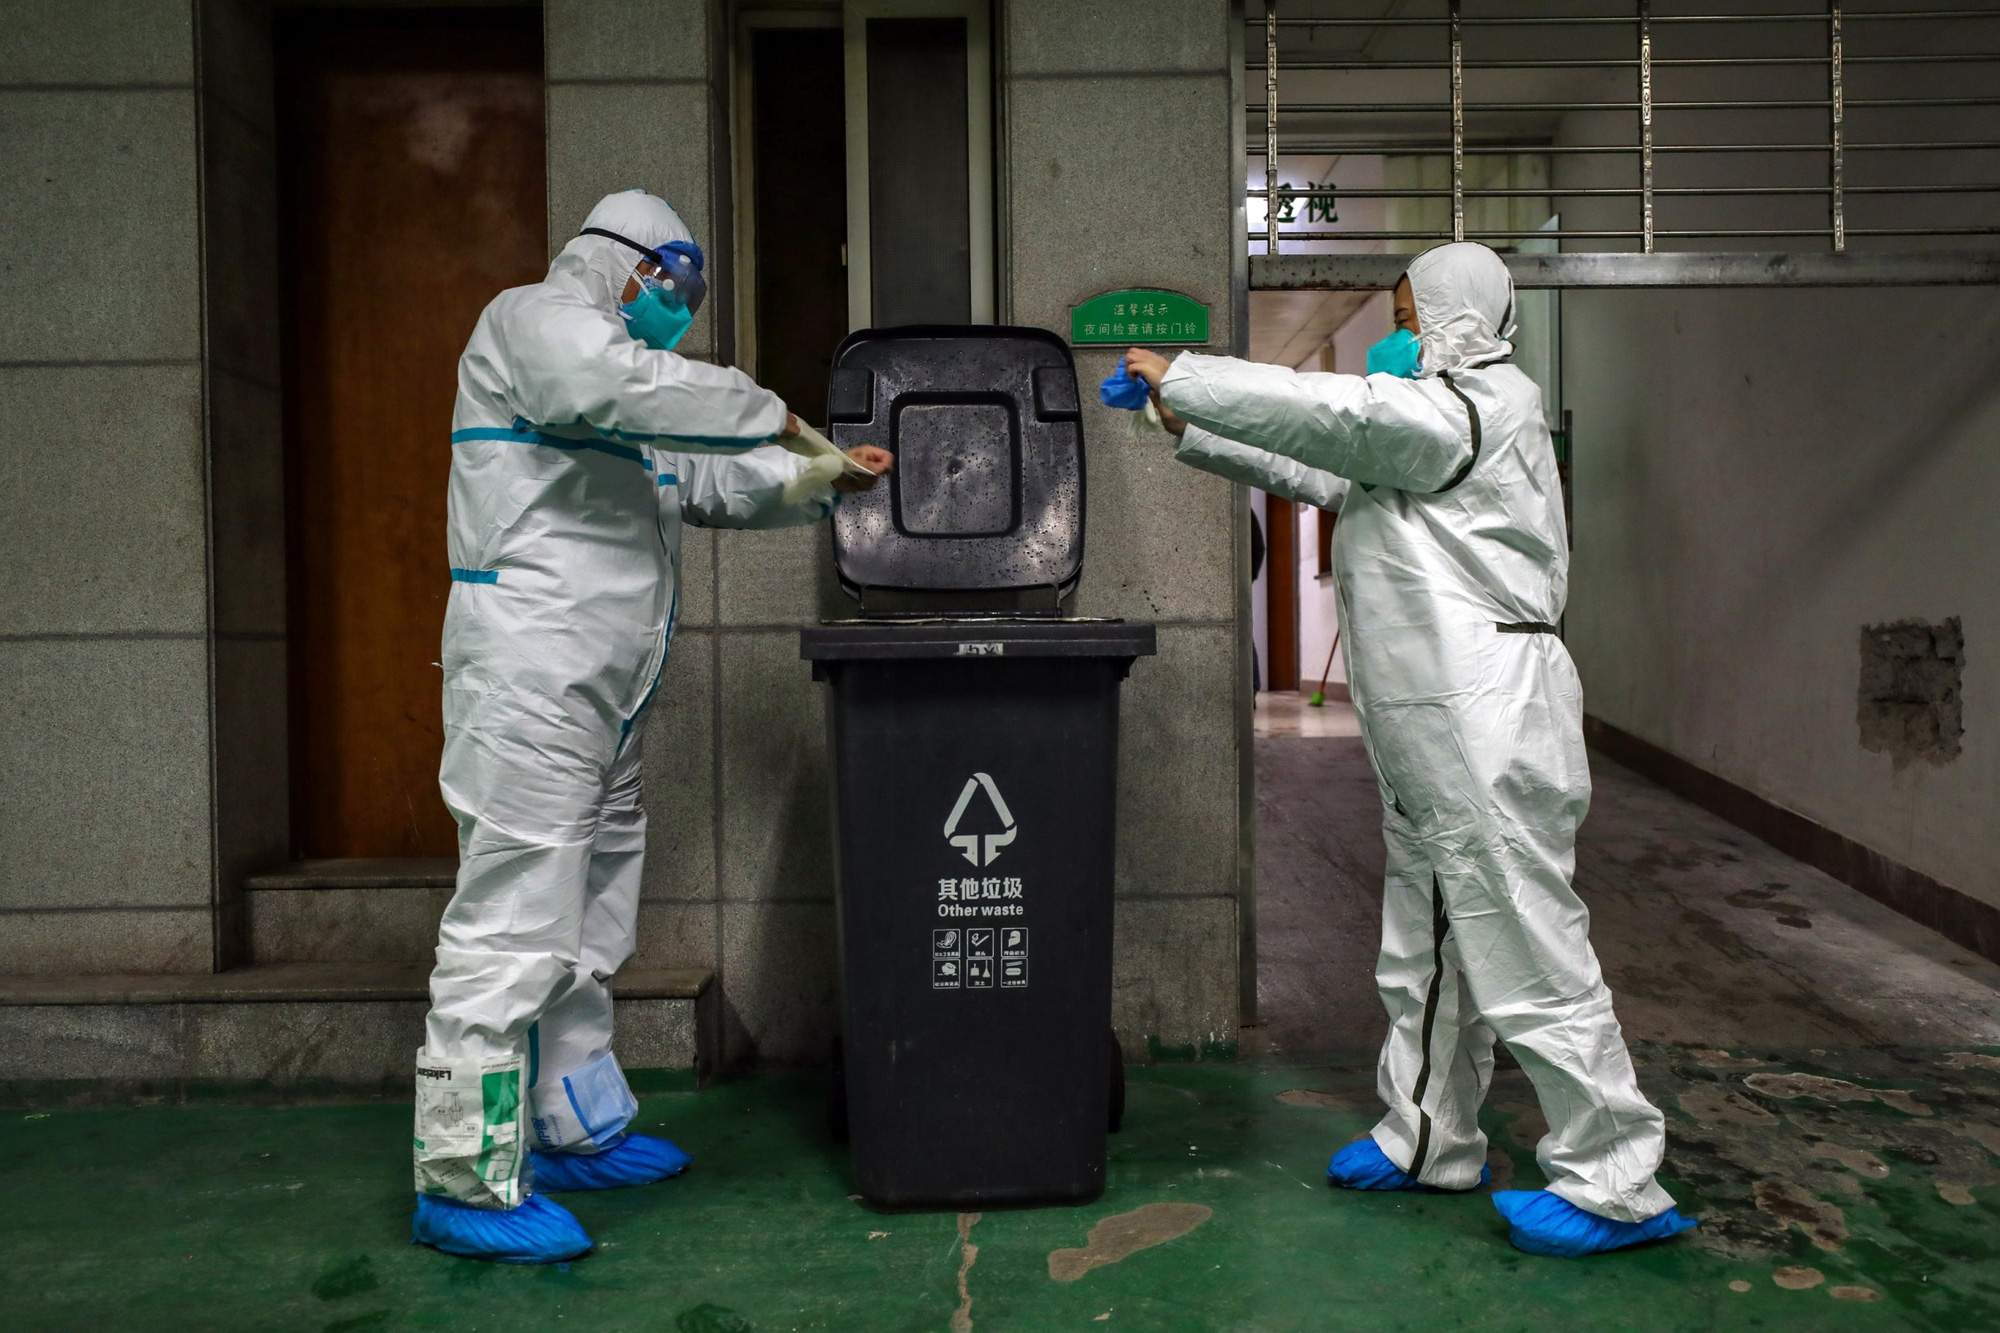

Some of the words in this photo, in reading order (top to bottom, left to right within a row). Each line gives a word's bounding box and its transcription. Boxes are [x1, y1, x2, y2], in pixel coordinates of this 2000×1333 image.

[1114, 303, 1169, 316] 温馨提示
[1084, 323, 1197, 336] 夜间检查请按门铃
[938, 877, 1023, 901] 其他垃圾
[938, 904, 978, 917] Other
[981, 904, 1024, 916] waste
